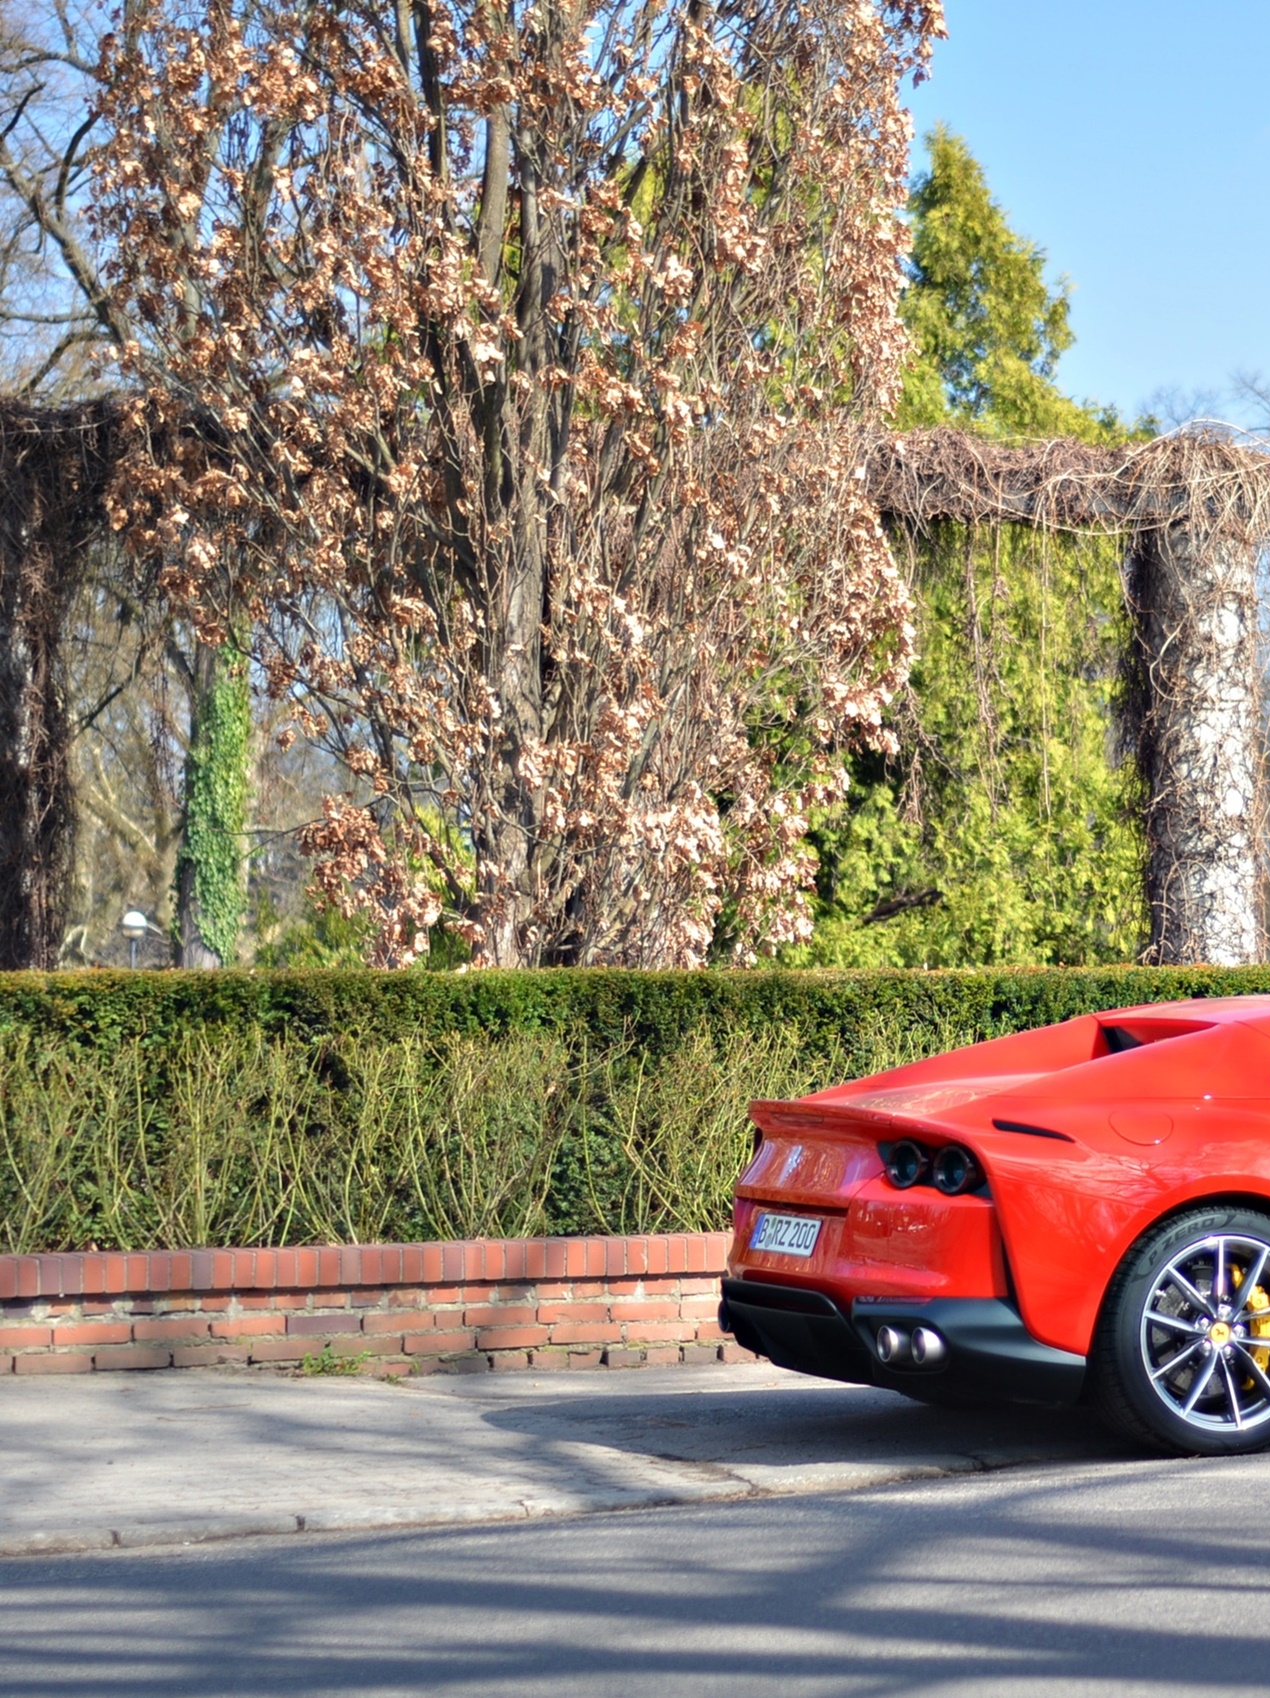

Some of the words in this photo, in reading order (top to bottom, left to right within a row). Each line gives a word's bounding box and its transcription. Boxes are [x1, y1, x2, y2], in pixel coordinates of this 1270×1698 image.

[758, 1218, 769, 1244] B
[788, 1221, 816, 1250] 200
[1149, 1250, 1158, 1266] P
[1162, 1218, 1215, 1251] ZERO
